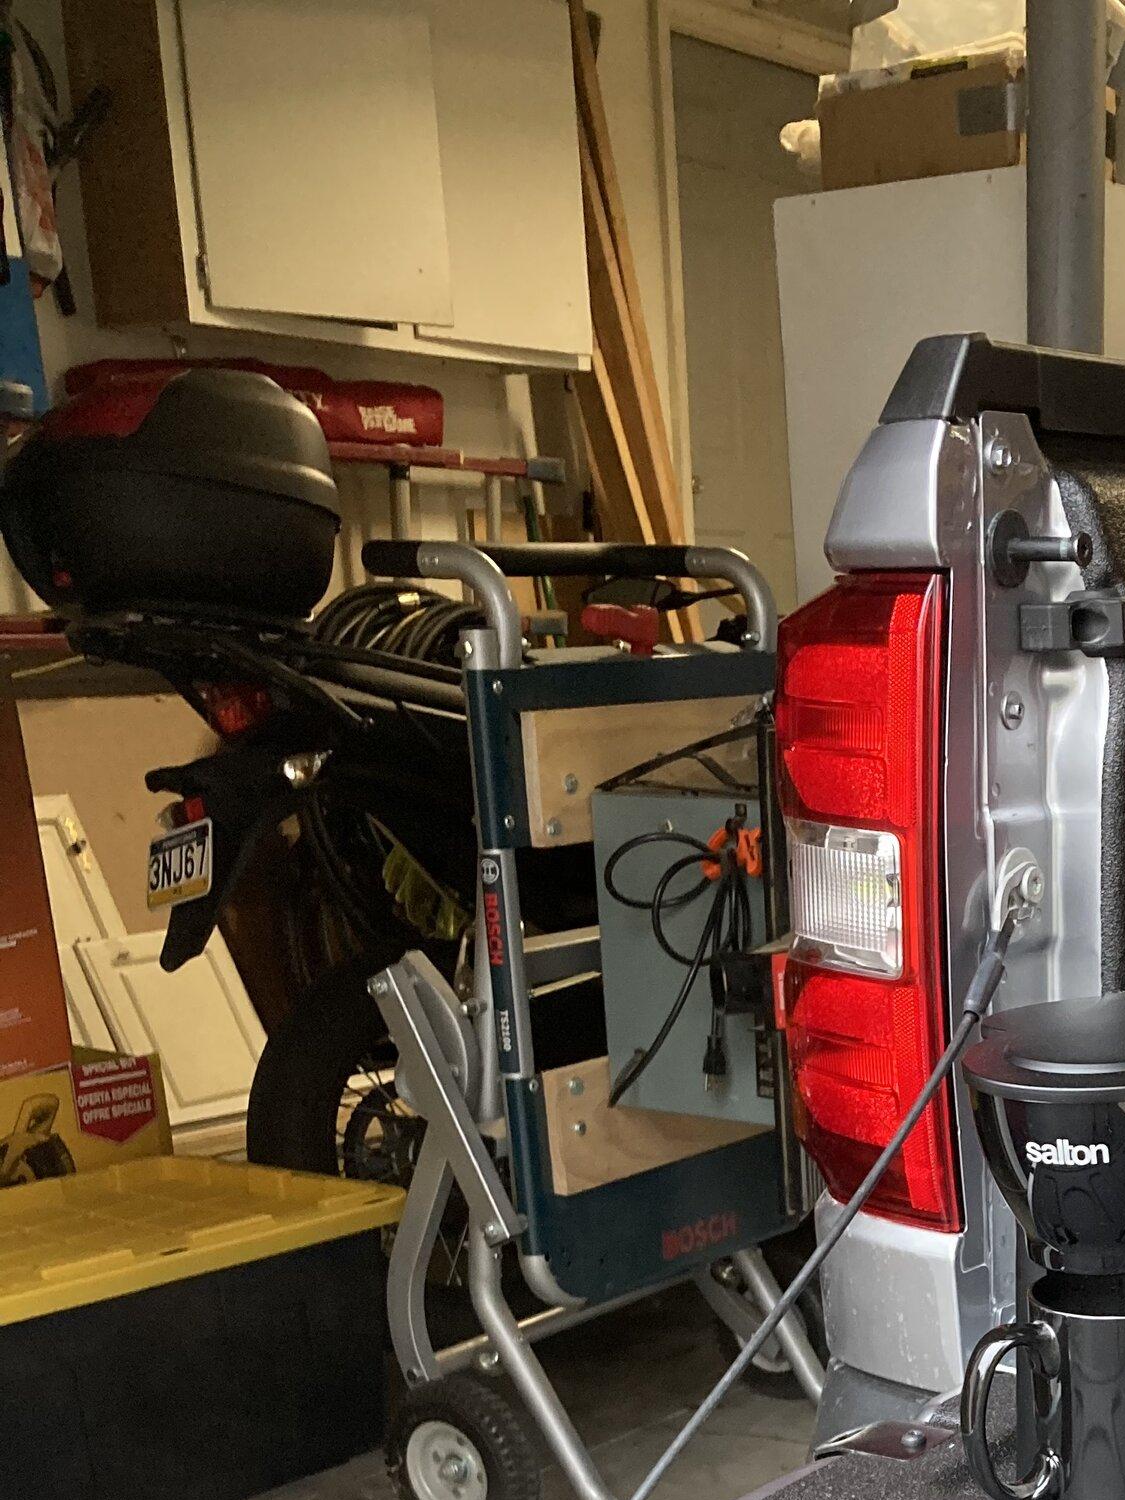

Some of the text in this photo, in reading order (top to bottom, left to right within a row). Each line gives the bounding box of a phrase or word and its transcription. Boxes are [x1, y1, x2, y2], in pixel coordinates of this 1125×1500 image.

[149, 838, 207, 892] 3NJ67
[484, 893, 503, 965] BOSCH
[78, 1081, 152, 1108] OFERTA ESPECIAL
[83, 1106, 111, 1124] OFFRE
[1025, 1138, 1110, 1166] salton
[662, 1212, 737, 1260] BOSCH
